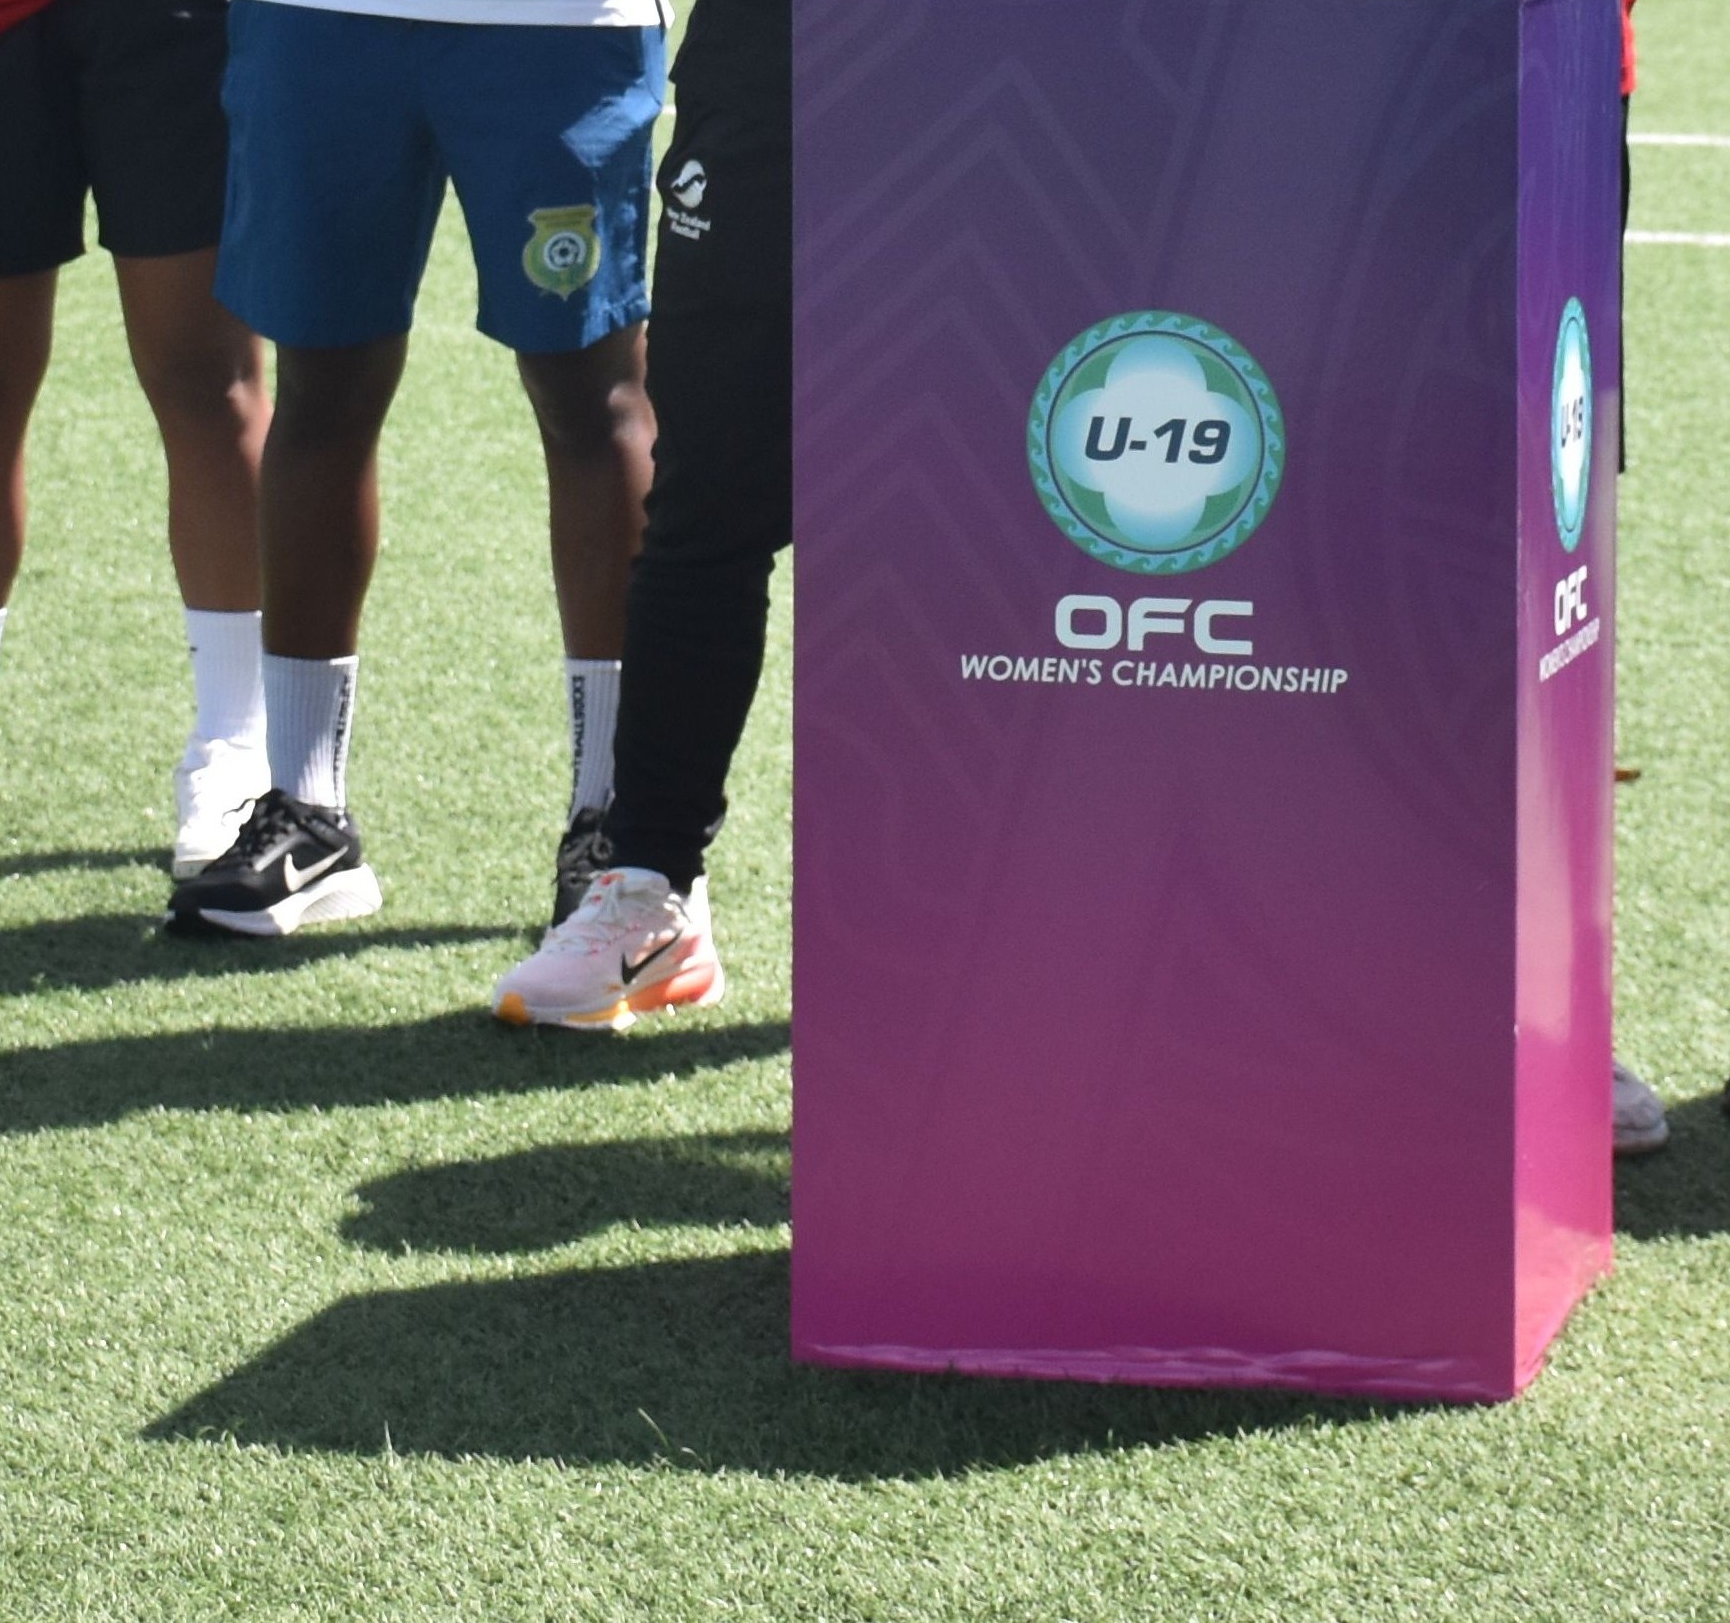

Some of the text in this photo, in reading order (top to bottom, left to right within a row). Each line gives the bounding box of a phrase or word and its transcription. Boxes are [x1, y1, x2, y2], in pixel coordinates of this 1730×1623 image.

[1084, 415, 1232, 466] U-19
[1054, 594, 1255, 656] OFC
[960, 653, 1349, 694] WOMEN'S CHAMPIONSHIP
